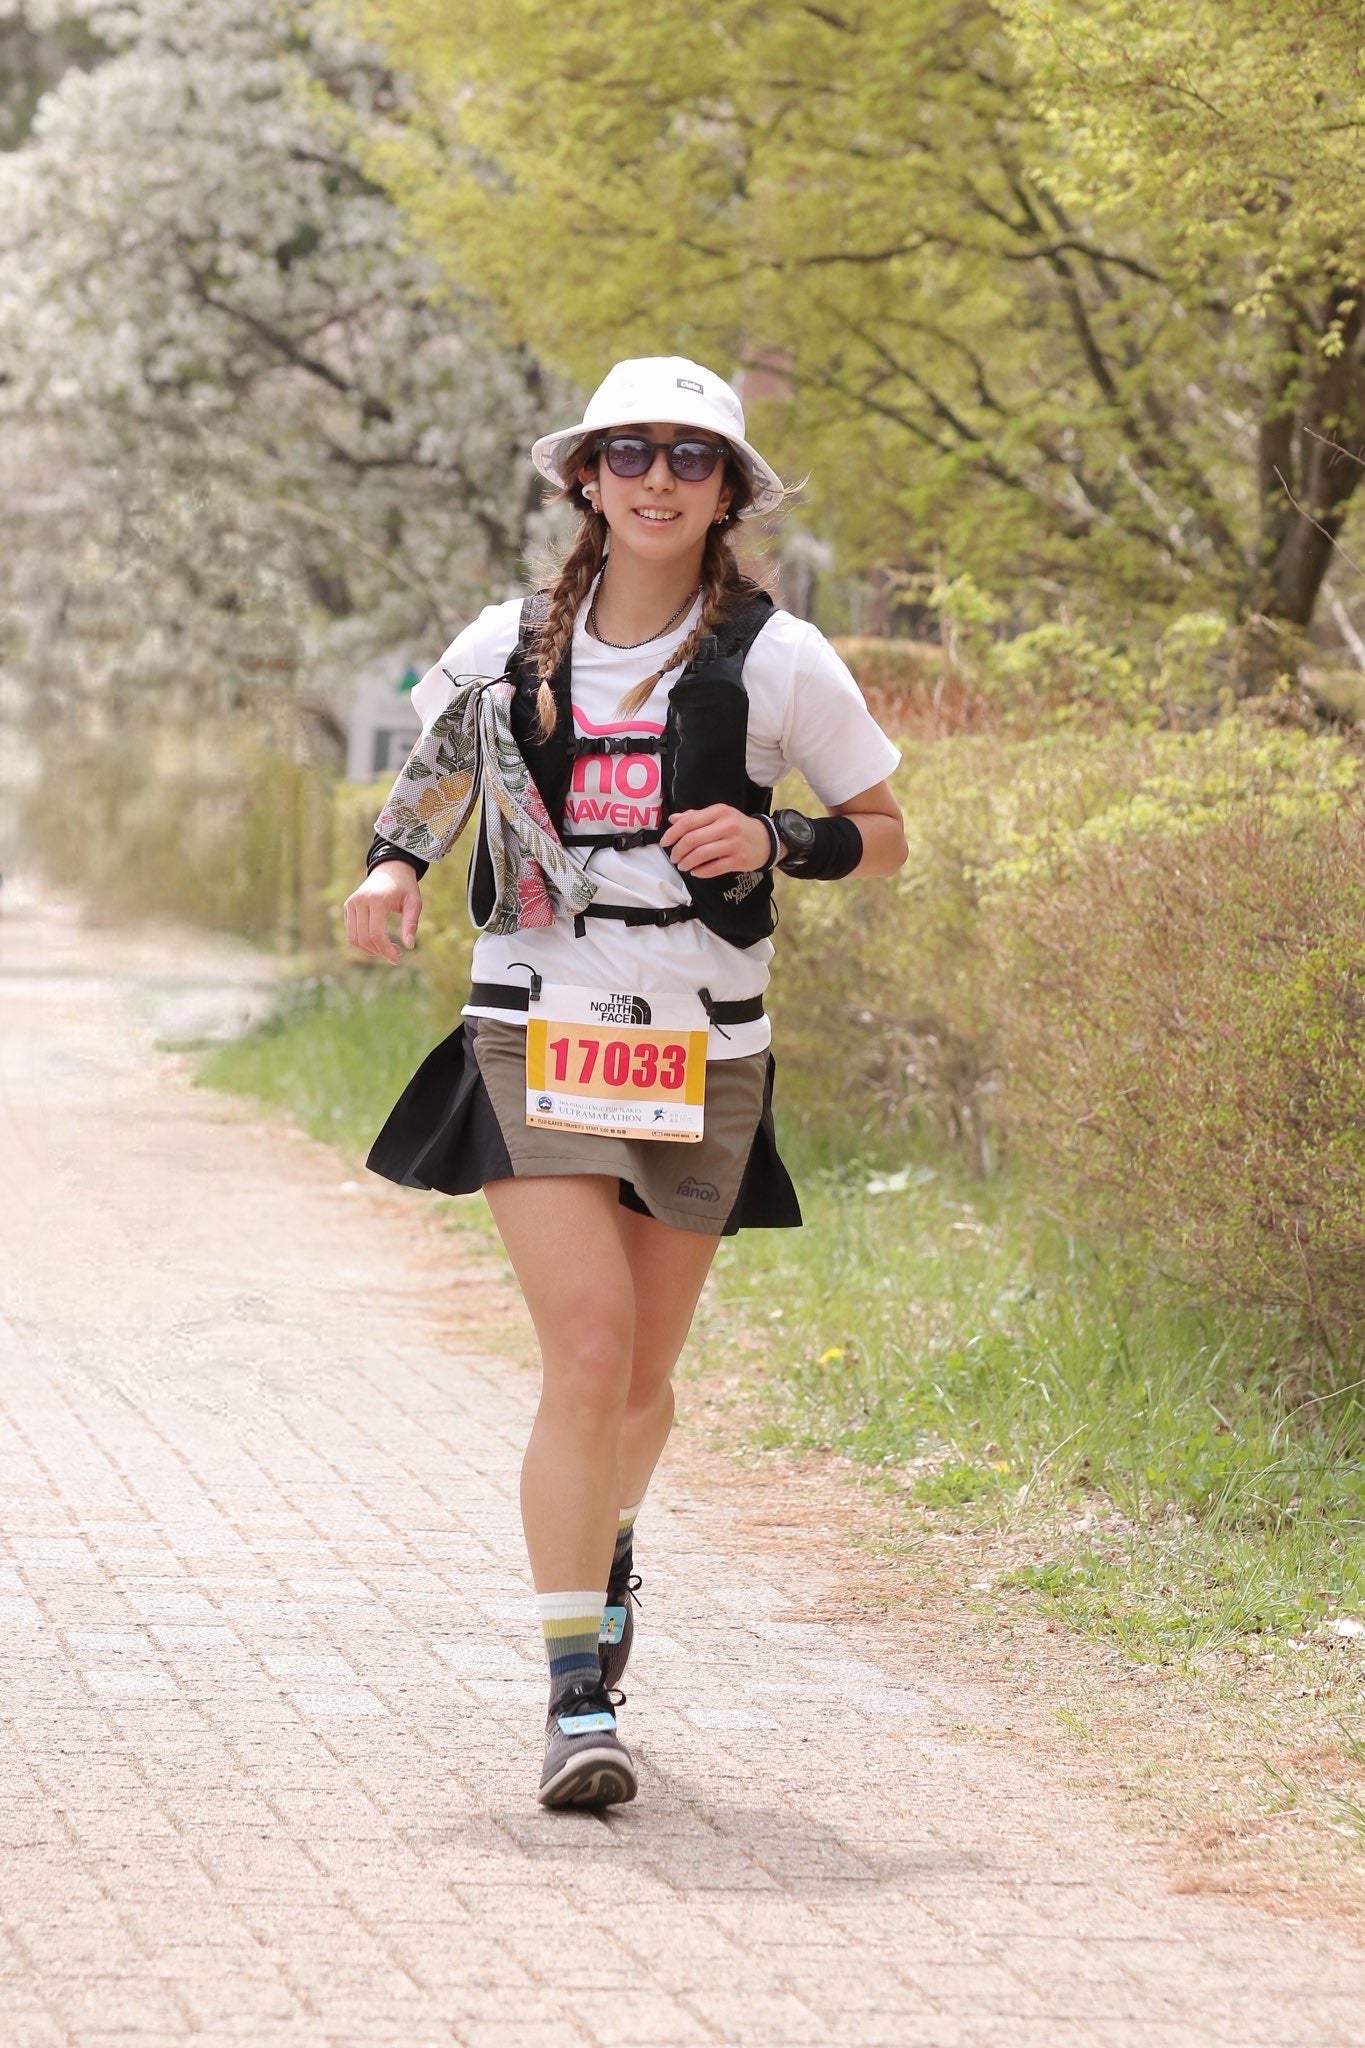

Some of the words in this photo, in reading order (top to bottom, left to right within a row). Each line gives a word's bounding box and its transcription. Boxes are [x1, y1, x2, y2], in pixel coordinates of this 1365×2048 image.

[735, 888, 753, 905] FACE
[609, 993, 632, 1005] THE
[590, 1002, 631, 1014] NORTH
[601, 1013, 631, 1024] FACE
[550, 1037, 687, 1090] 17033
[559, 1107, 642, 1123] ULTRAMARATHON
